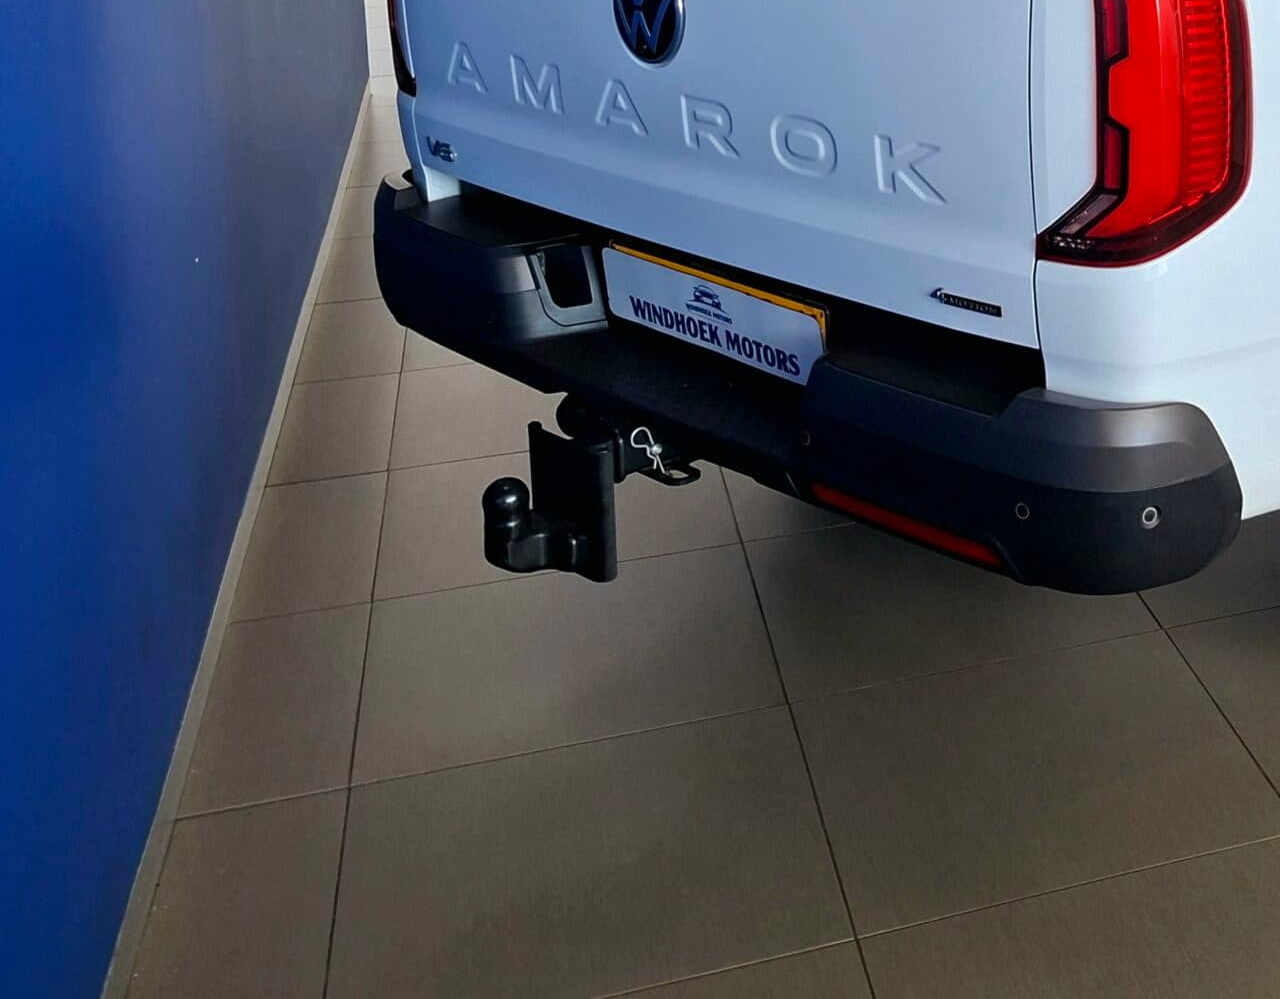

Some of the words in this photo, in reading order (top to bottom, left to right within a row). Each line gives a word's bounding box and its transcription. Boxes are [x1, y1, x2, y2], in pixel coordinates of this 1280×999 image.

[446, 41, 948, 205] AMAROK
[629, 294, 722, 348] WINDHOEK
[724, 329, 801, 377] MOTORS
